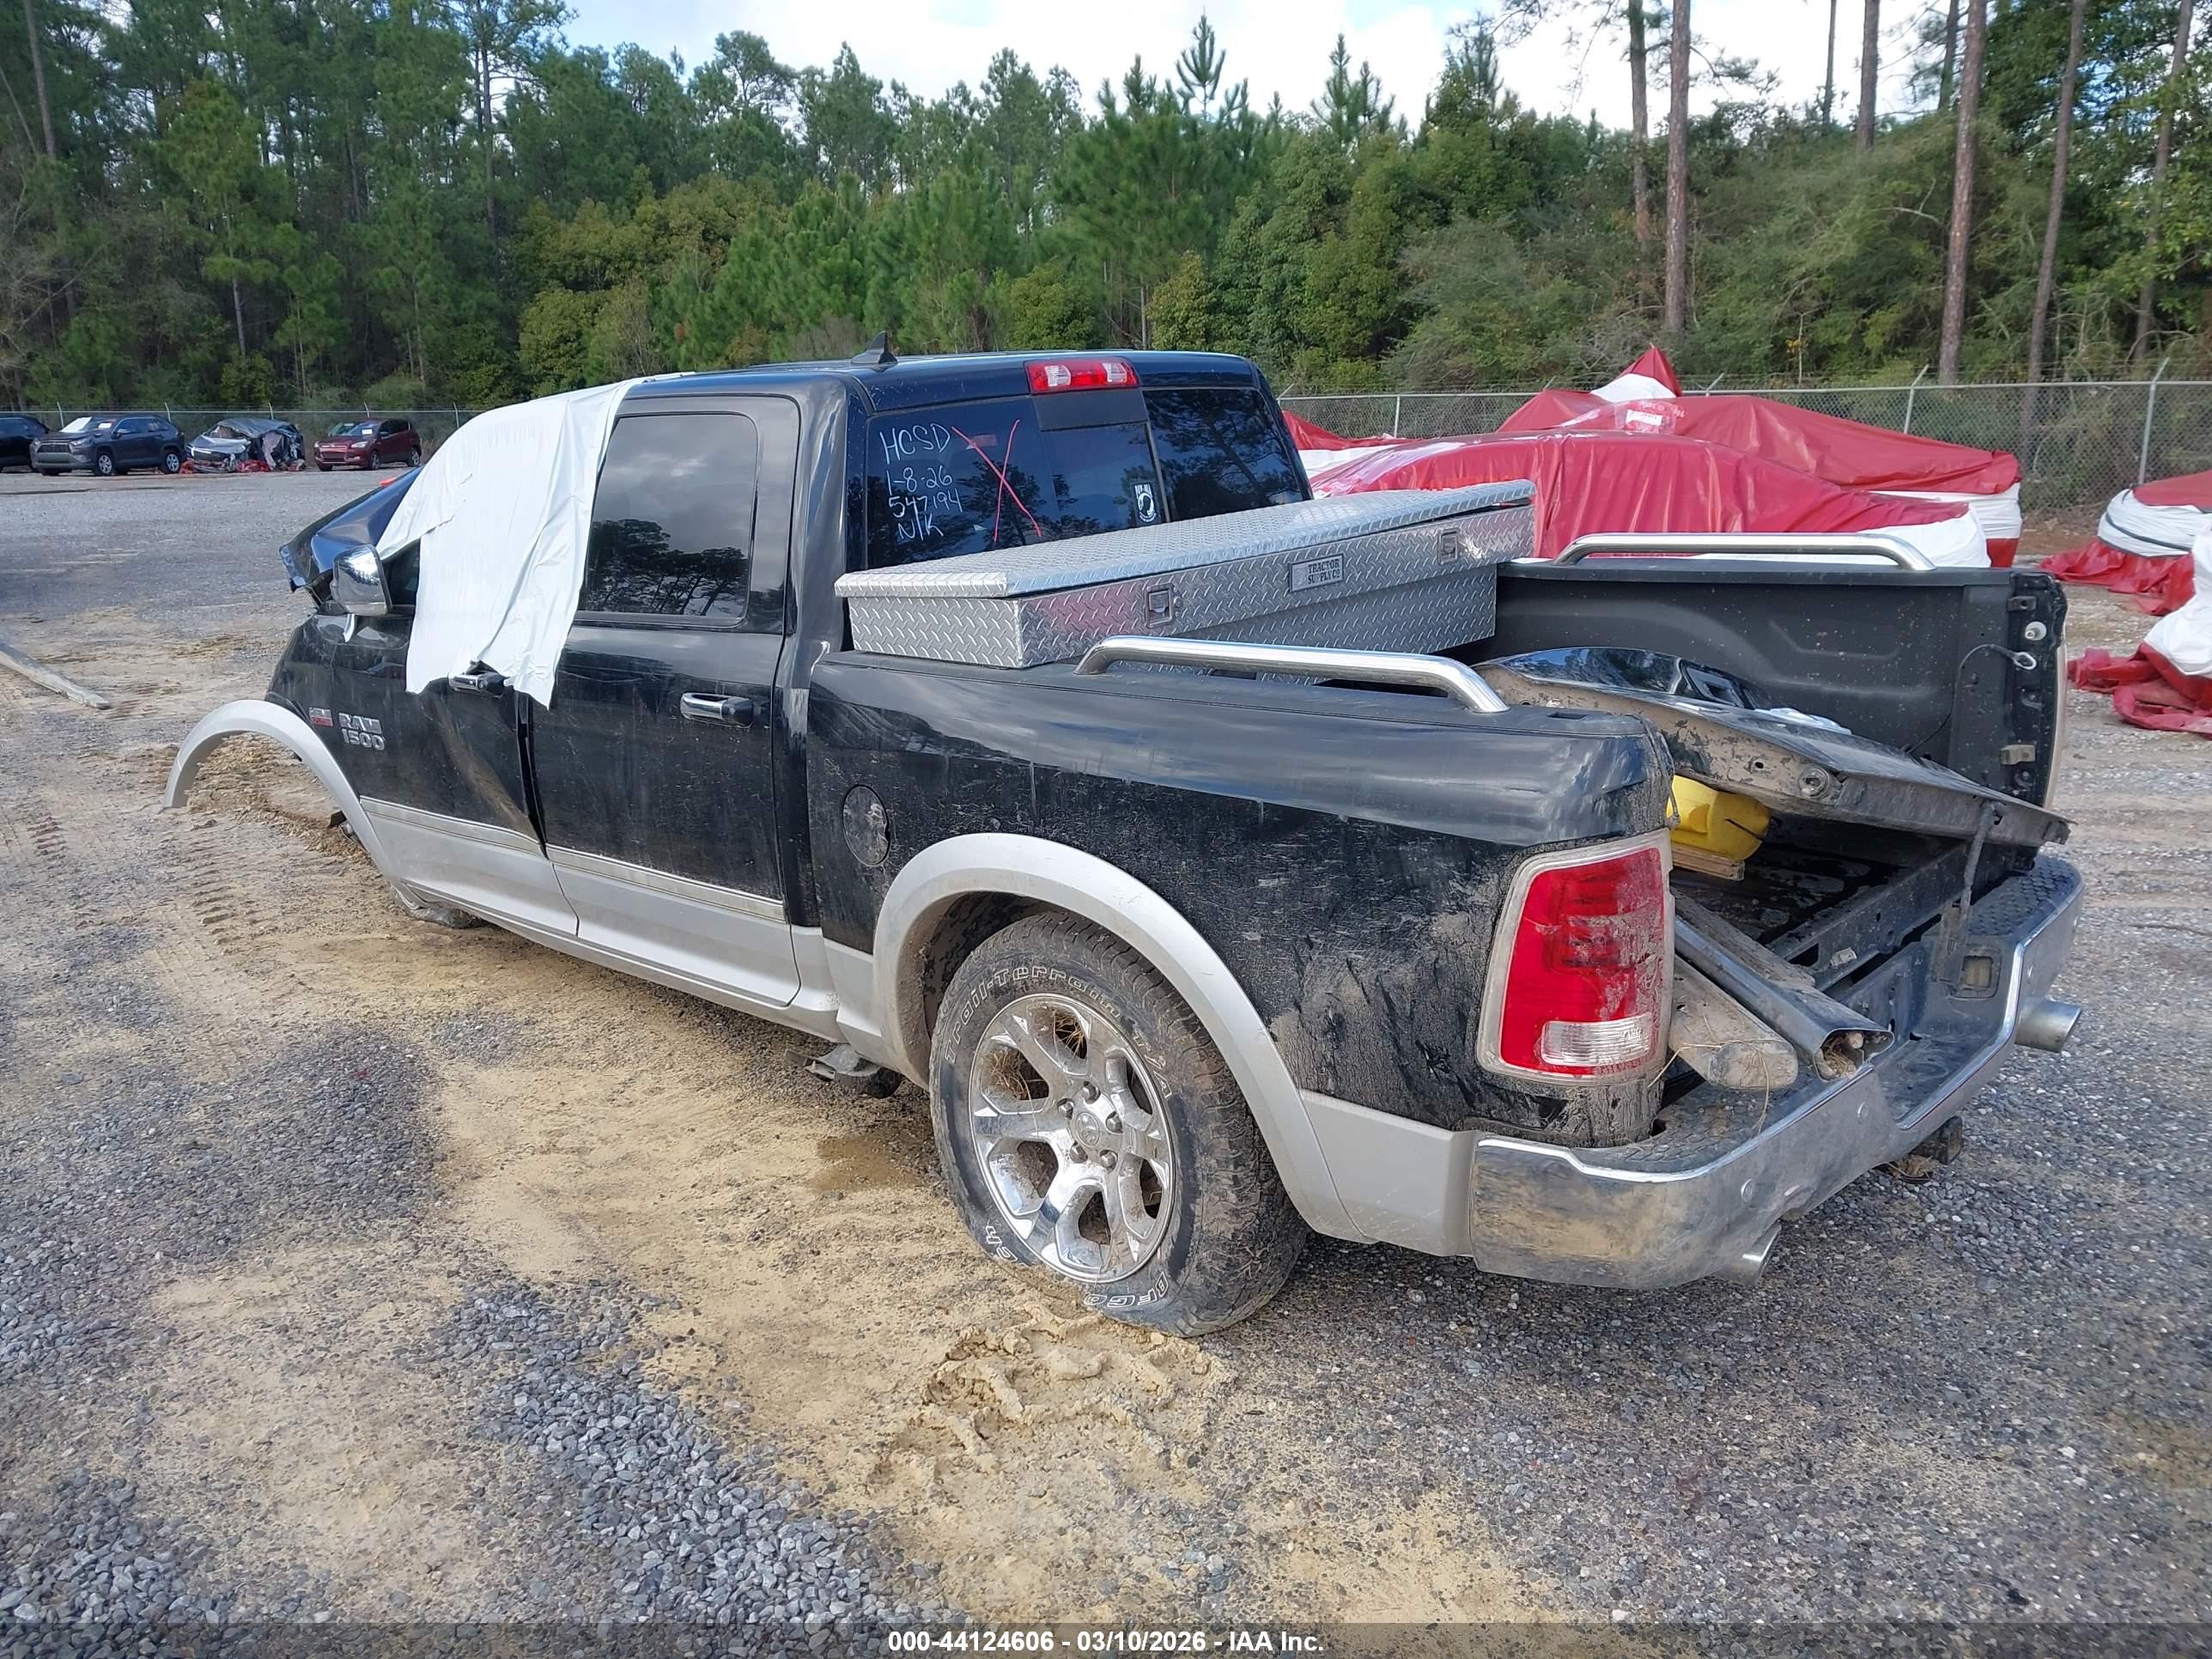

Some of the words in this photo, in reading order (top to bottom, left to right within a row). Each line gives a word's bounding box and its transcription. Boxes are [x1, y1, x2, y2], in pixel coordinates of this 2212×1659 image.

[879, 422, 951, 465] HCSD
[886, 465, 953, 496] 1-8-26
[1308, 559, 1340, 574] TRACTOR
[338, 713, 382, 734] RAM
[342, 728, 386, 750] 1500
